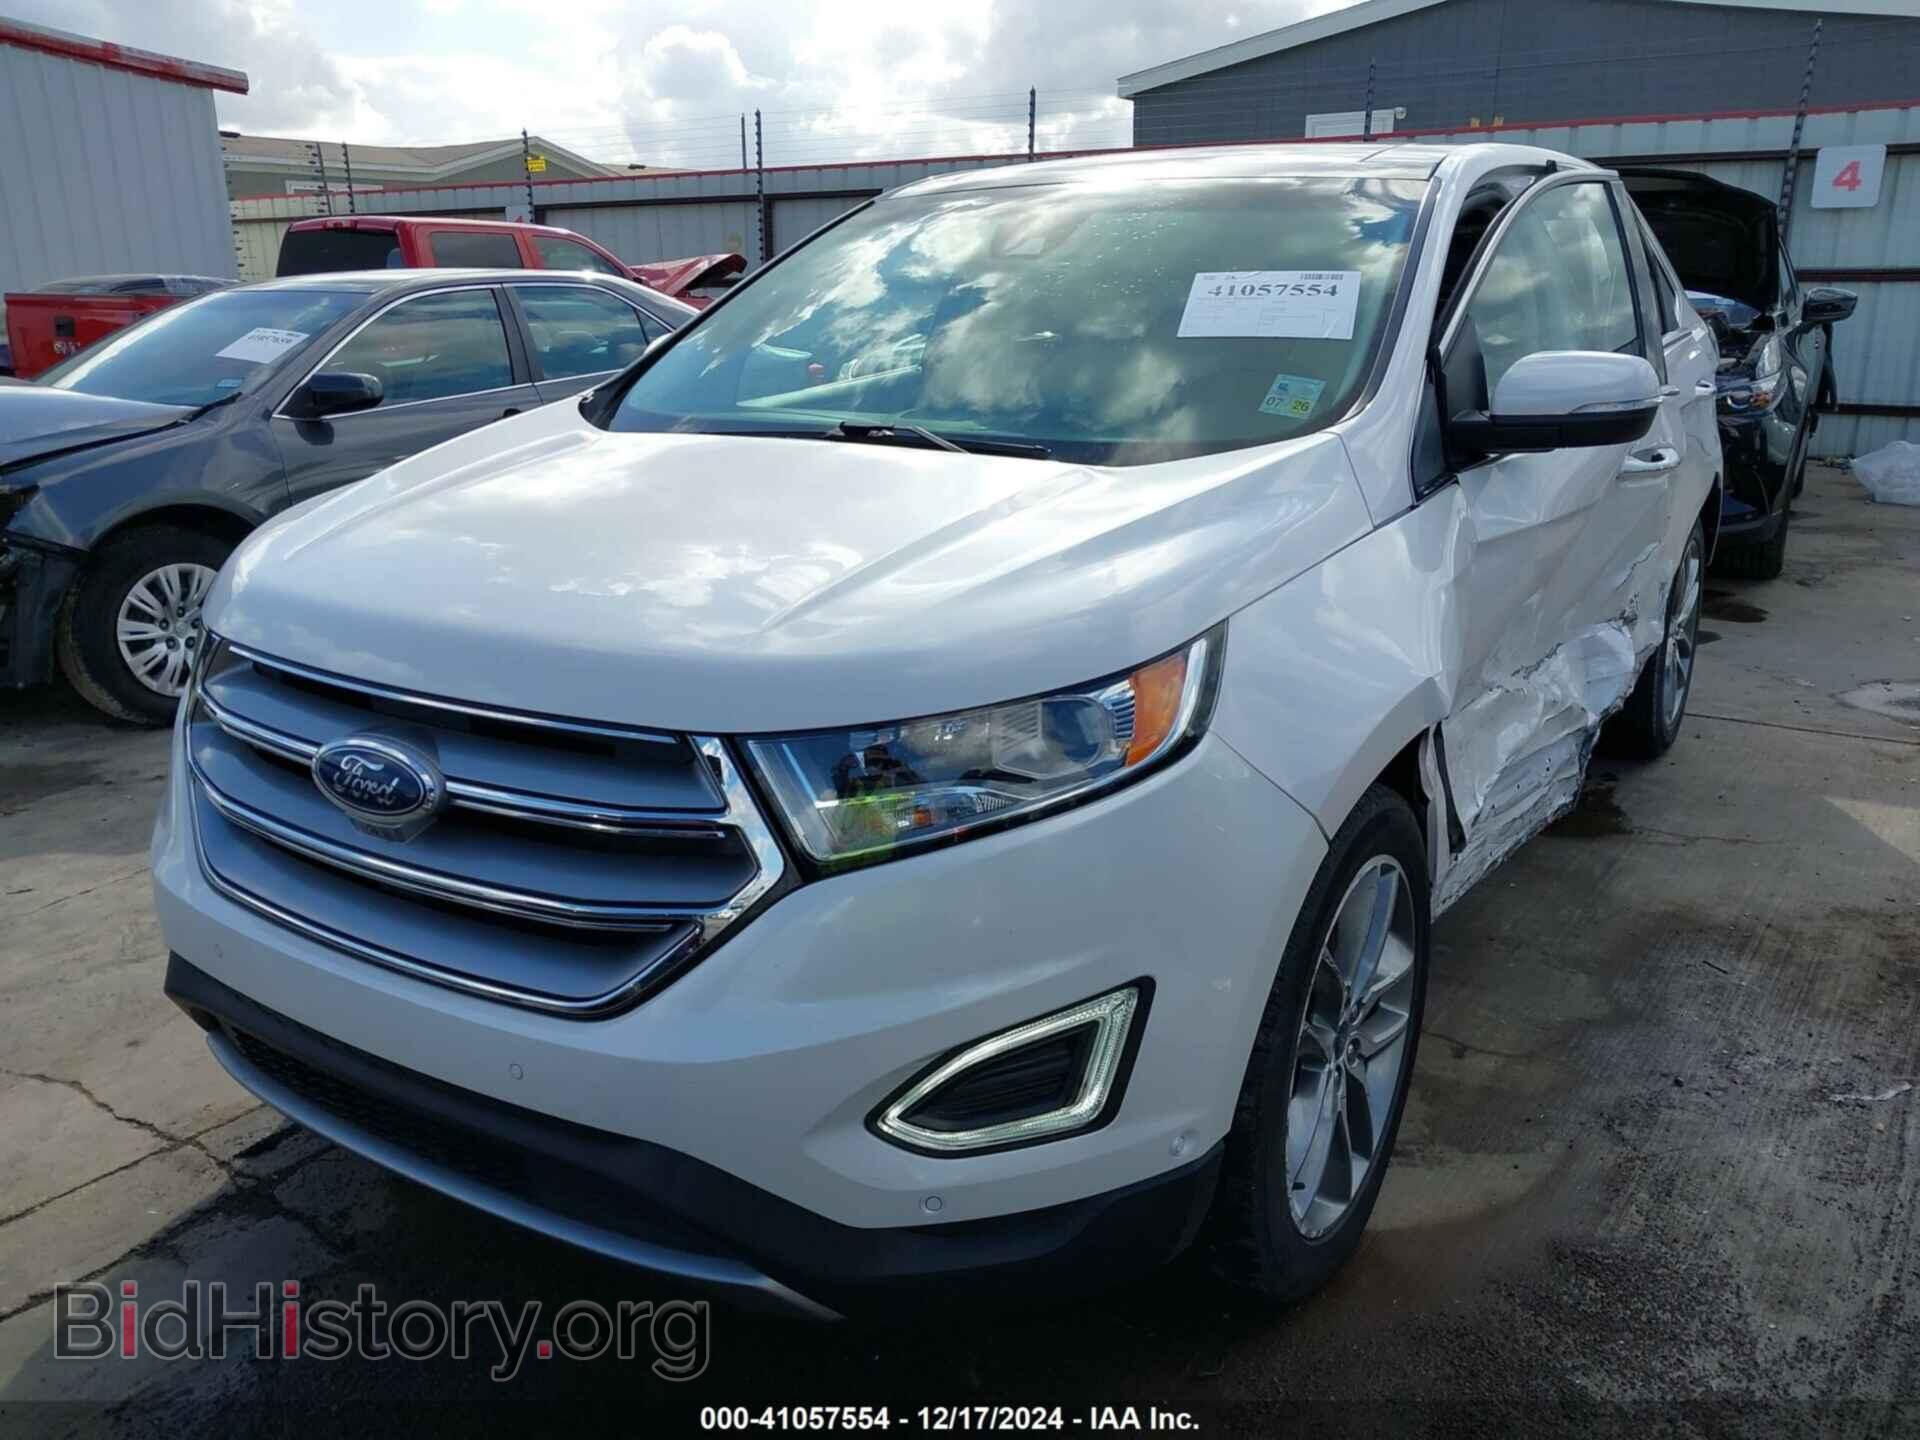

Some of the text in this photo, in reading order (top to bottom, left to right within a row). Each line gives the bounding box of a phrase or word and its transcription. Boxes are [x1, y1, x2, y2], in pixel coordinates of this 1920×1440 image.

[1831, 160, 1862, 192] 4
[1207, 283, 1338, 297] 41057554
[334, 754, 400, 797] Ford
